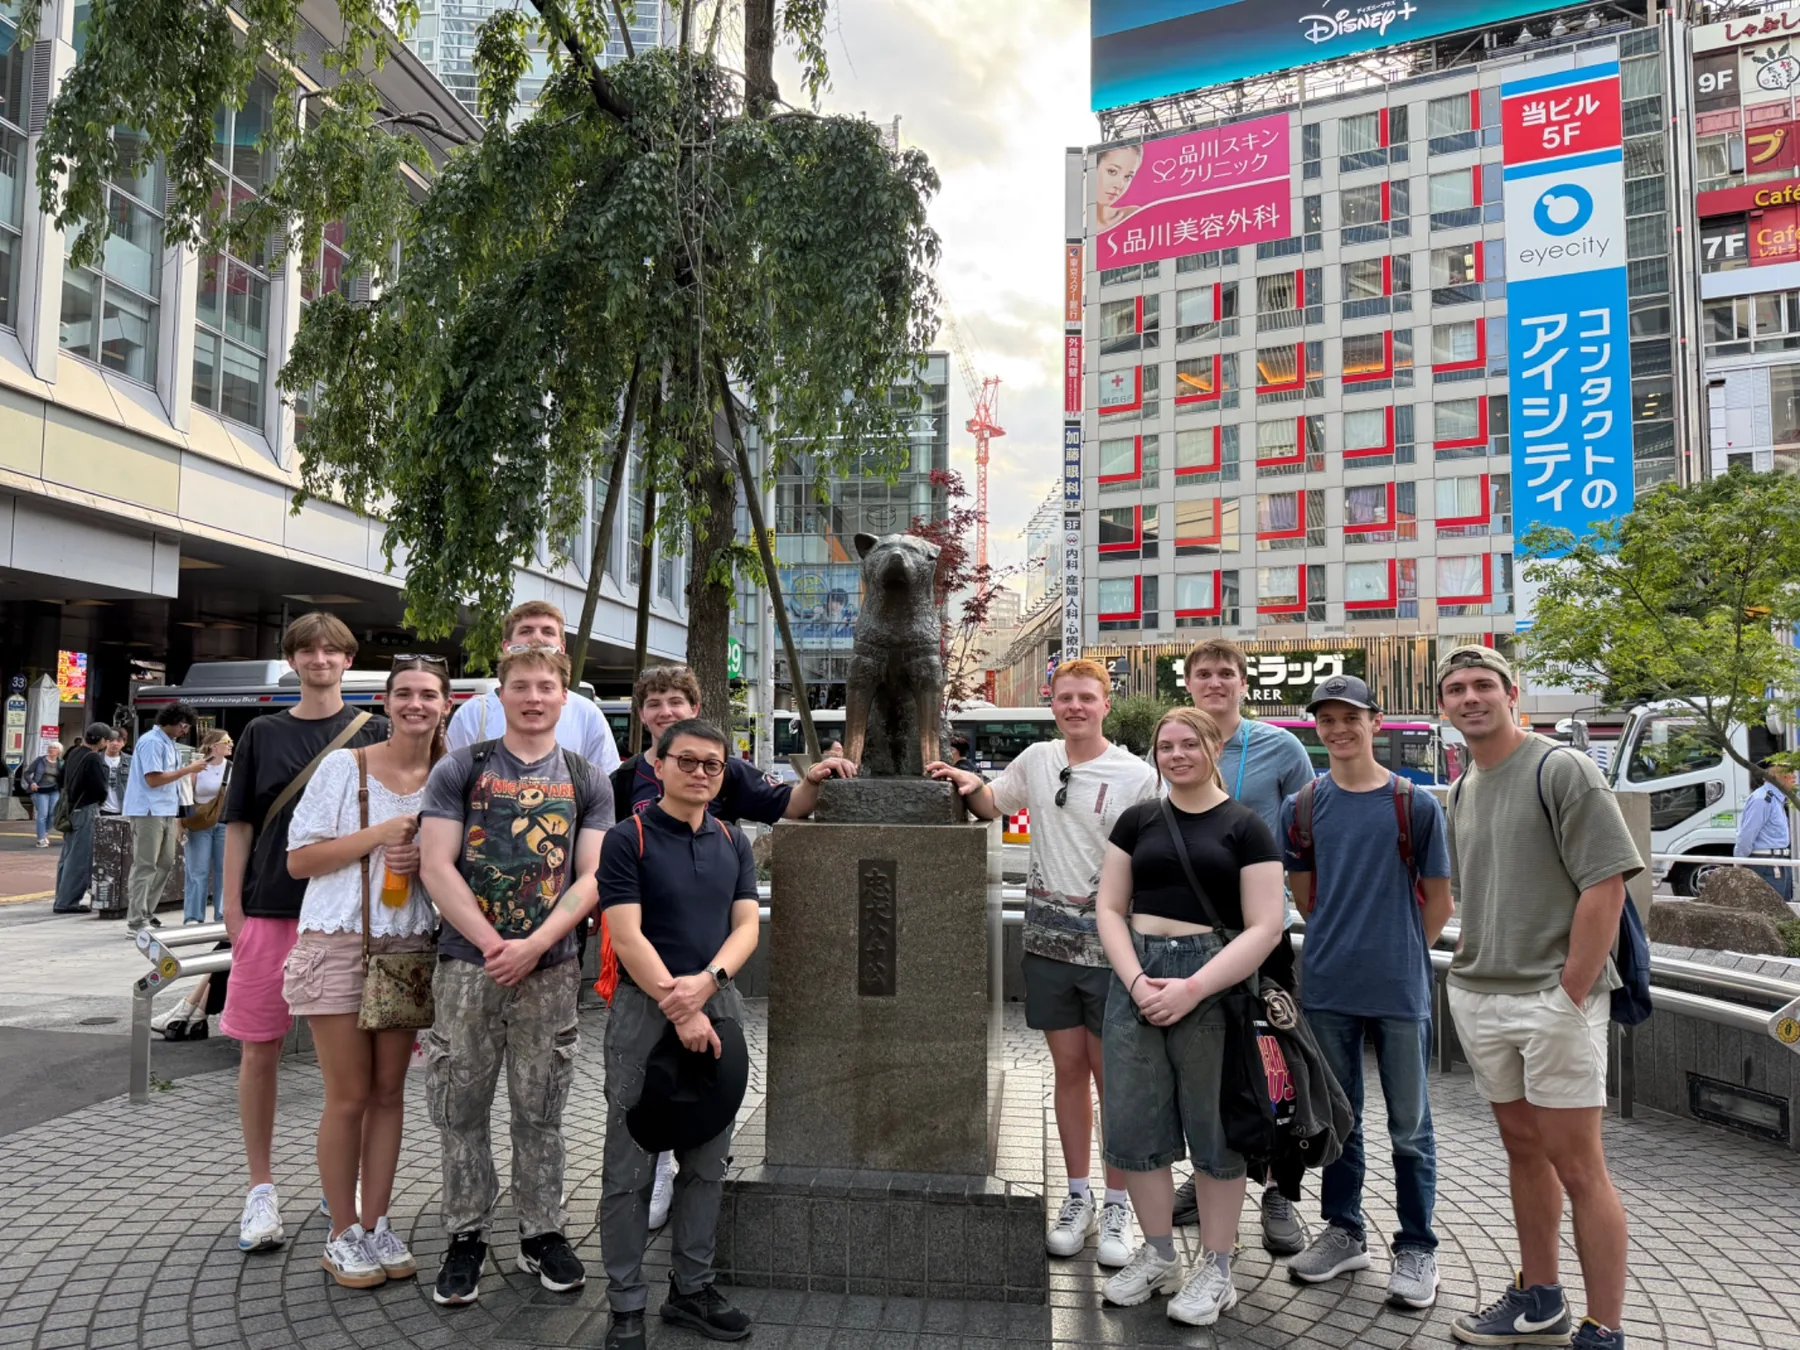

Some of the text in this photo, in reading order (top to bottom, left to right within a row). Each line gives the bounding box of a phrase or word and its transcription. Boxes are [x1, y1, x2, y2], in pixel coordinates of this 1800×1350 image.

[1725, 12, 1800, 41] しゃぶし
[1698, 69, 1733, 93] 9F
[1522, 93, 1600, 127] 当ビル
[1179, 129, 1279, 166] 品川スキン
[1542, 122, 1581, 149] 5F
[1748, 129, 1784, 163] プ
[1180, 153, 1268, 186] クリニック
[1123, 202, 1280, 254] 品川美容外科
[1519, 236, 1610, 266] eyecity
[1702, 233, 1746, 260] 7F
[1759, 244, 1800, 257] レストラ
[1521, 313, 1574, 511] アイシティ
[1579, 308, 1618, 509] コンタクトの
[1065, 430, 1080, 496] 加藤眼科
[1066, 501, 1079, 509] 5F
[1066, 521, 1079, 529] 3F
[1065, 548, 1079, 570] 内科
[12, 676, 25, 687] 33
[179, 696, 208, 704] Hybrid
[208, 696, 241, 704] Nonstop
[863, 867, 892, 987] 忠犬ハチ公
